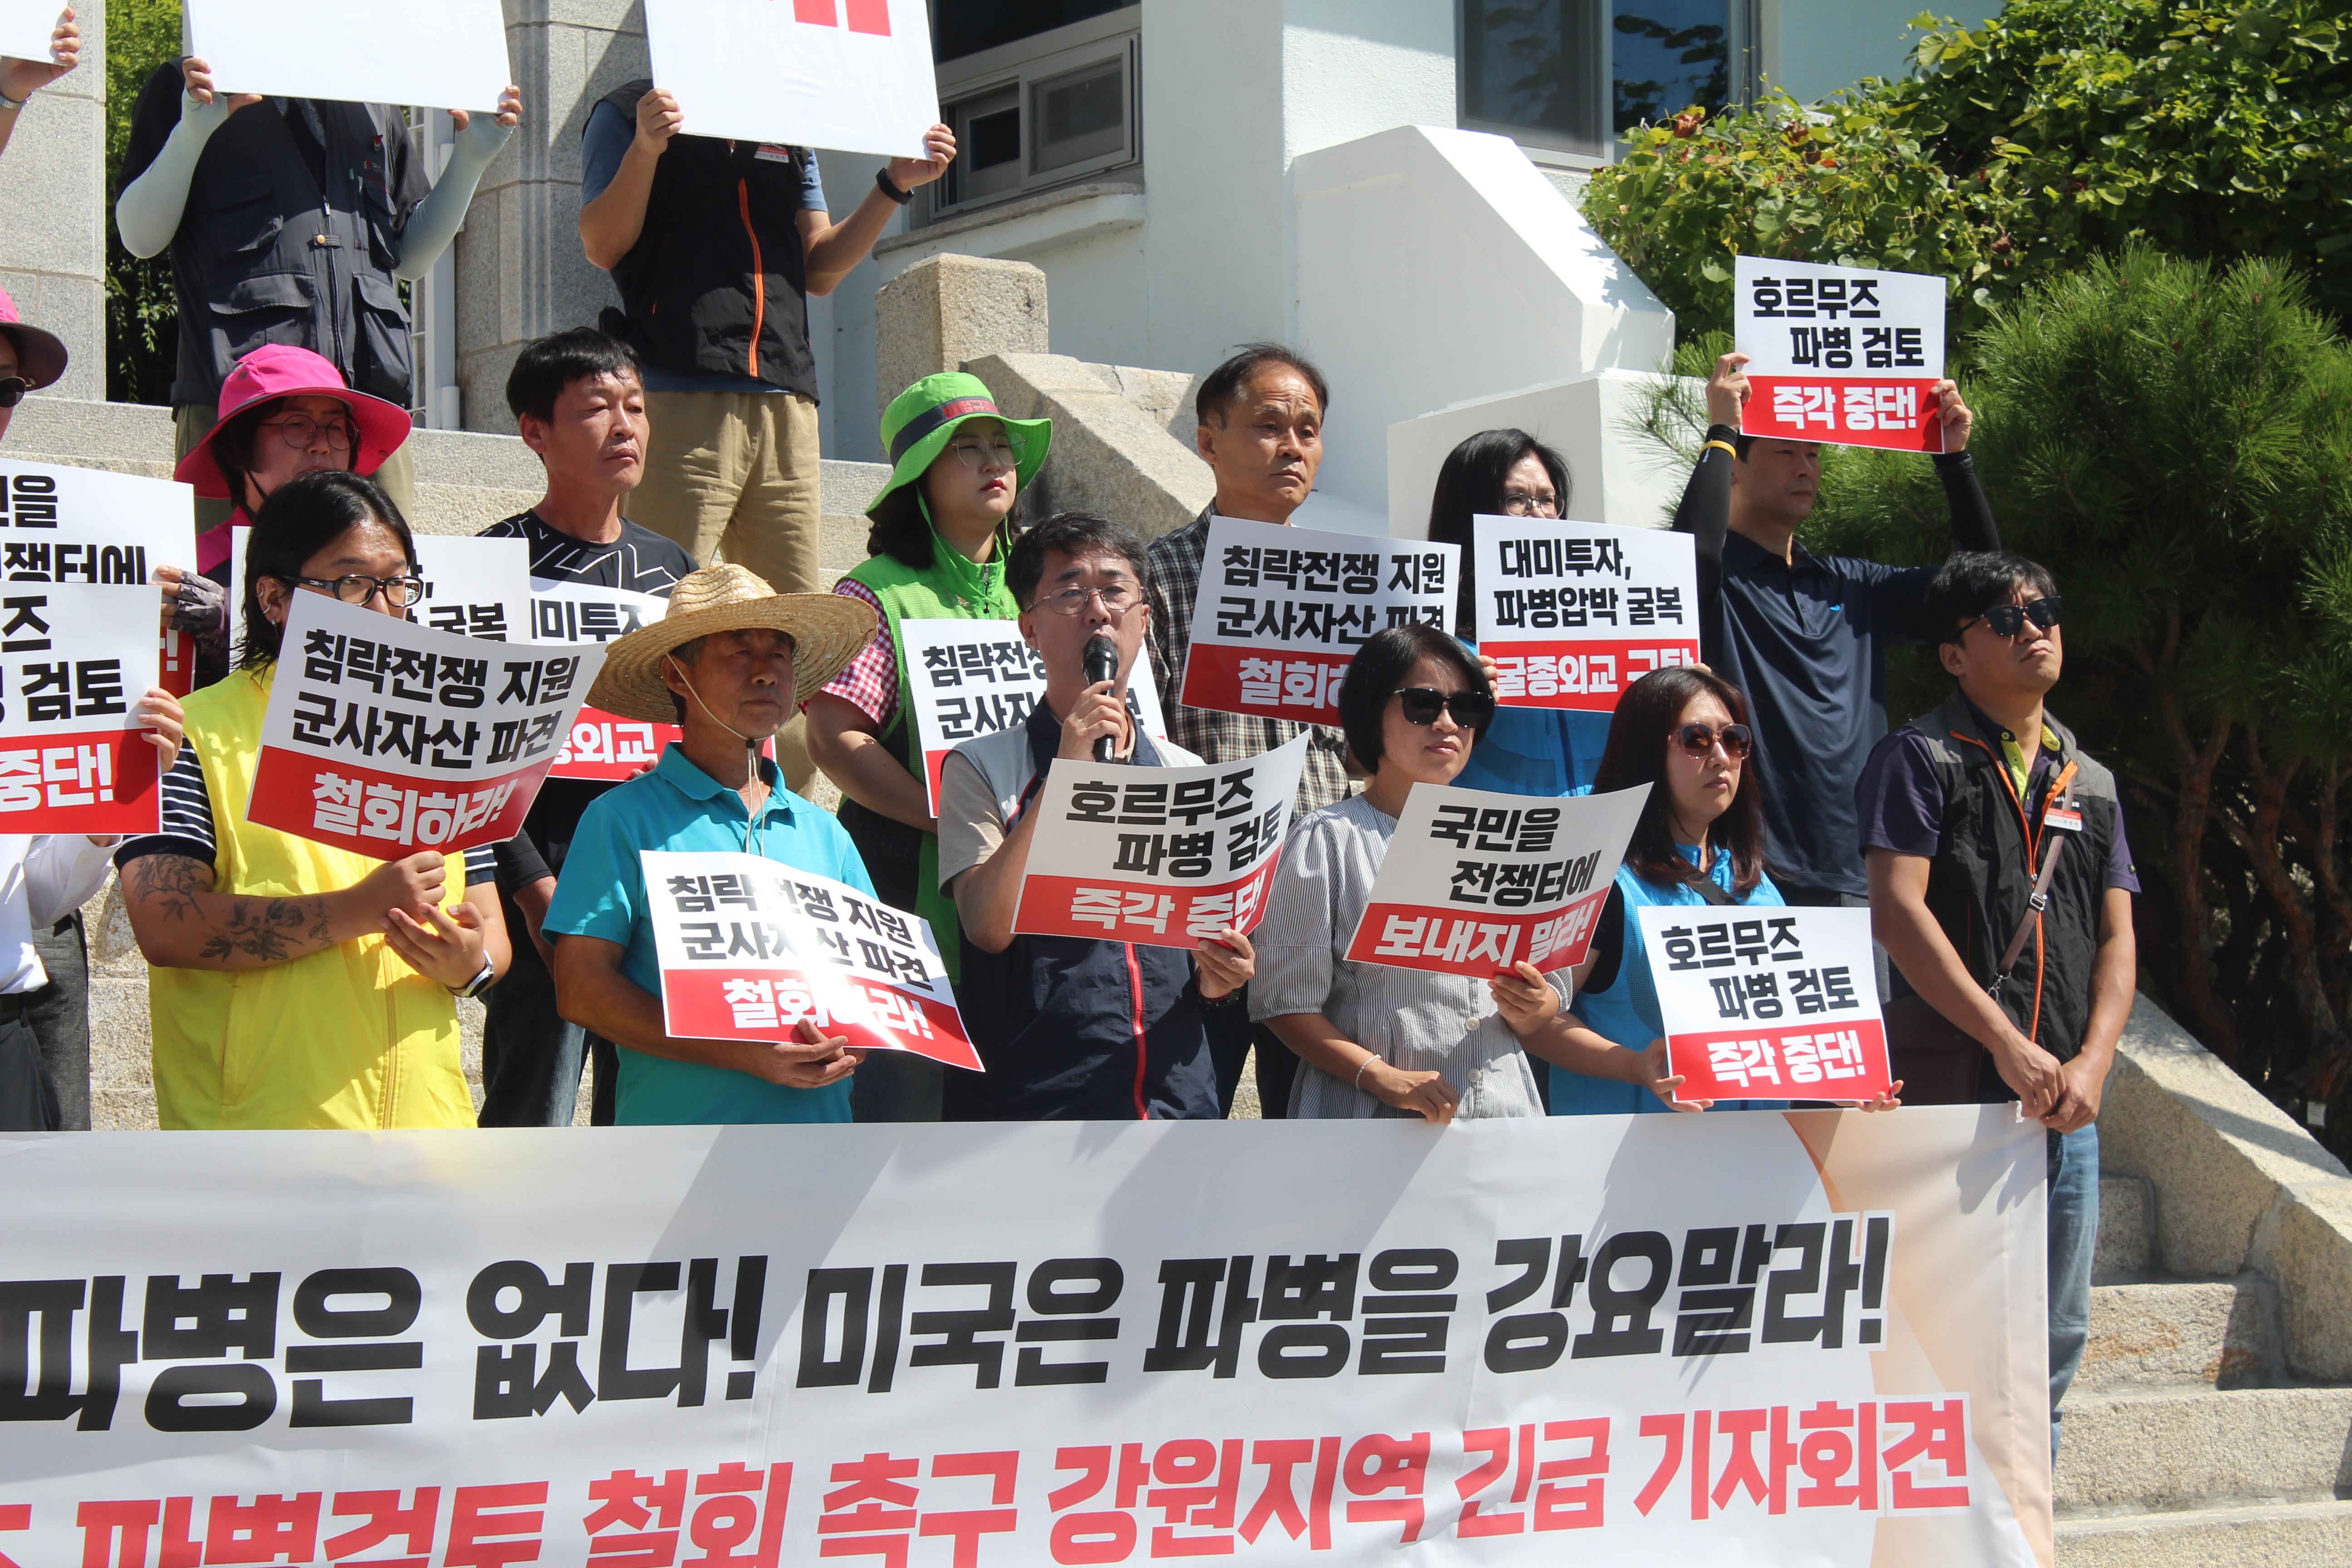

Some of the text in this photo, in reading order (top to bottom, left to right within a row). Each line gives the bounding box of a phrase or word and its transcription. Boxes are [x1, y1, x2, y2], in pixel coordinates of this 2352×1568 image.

[1752, 277, 1881, 319] 호르무즈
[1789, 326, 1925, 368] 파병 검토
[1773, 386, 1916, 431] 즉각 중단!
[0, 475, 58, 529] 을
[0, 542, 147, 585] 쟁터에
[1223, 545, 1445, 594] 침략전쟁 지원
[1499, 538, 1631, 581] 대미투자,
[1216, 596, 1376, 644] 군사자산
[1494, 586, 1684, 628] 파병압박 굴복
[21, 659, 127, 722] 검토
[304, 629, 580, 708] 침략전쟁 지원
[1496, 654, 1618, 696] 굴종외교
[292, 691, 563, 769] 군사자산 파견
[935, 691, 1036, 740] 군사자
[0, 743, 114, 813] 중단!
[1066, 767, 1254, 826] 호르무즈
[312, 771, 518, 846] 철회하라!
[1430, 803, 1562, 853] 국민을
[1112, 799, 1283, 877] 파병 검토
[1070, 868, 1267, 940] 즉각 중단!
[1450, 849, 1602, 907] 전쟁터에
[842, 895, 916, 950] 지원
[1374, 911, 1590, 967] 보내지 말라!
[1661, 917, 1803, 970] 호르무즈
[856, 937, 935, 992] 파견
[1708, 966, 1860, 1020] 파병 검토
[1707, 1029, 1864, 1088] 즉각 중단!
[0, 1216, 1890, 1433] 파병은 없다! 미국은 파병을 강요말라!
[75, 1481, 549, 1568] 파병검토
[583, 1461, 794, 1568] 철회
[817, 1450, 1020, 1568] 촉구
[1047, 1432, 1431, 1565] 강원지역
[1454, 1416, 1611, 1539] 긴급
[1633, 1398, 1970, 1521] 기자회견
